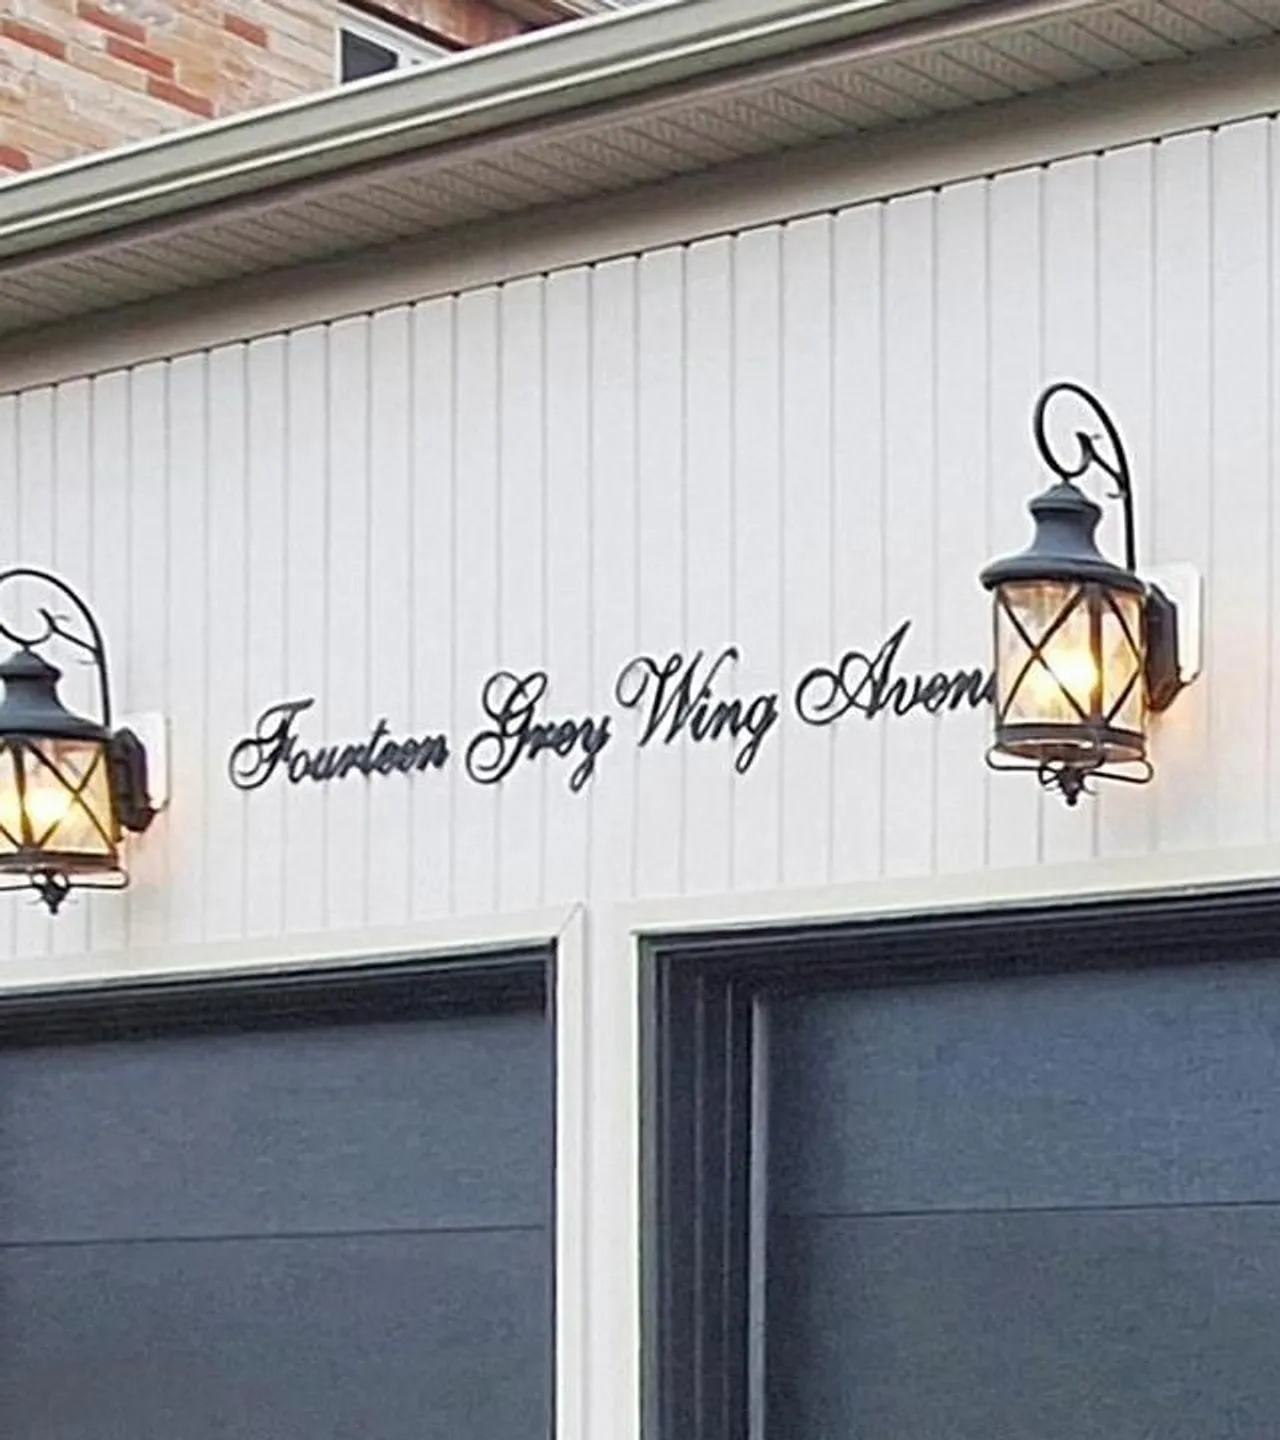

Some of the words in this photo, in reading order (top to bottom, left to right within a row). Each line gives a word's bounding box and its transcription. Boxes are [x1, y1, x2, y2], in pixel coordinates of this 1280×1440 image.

[229, 697, 450, 792] Fourteen
[465, 670, 610, 793] Grey
[615, 647, 779, 774] Wing
